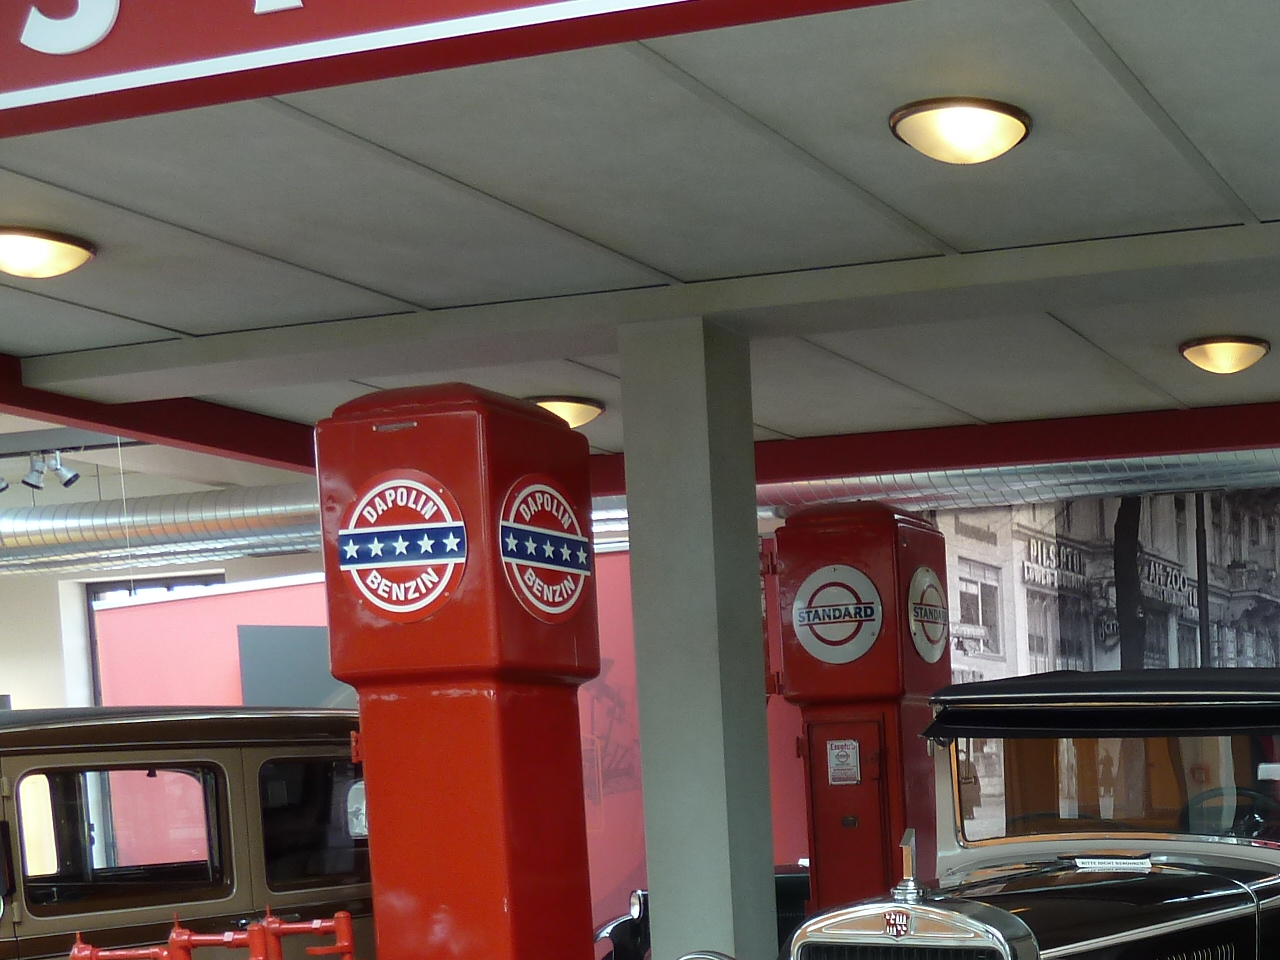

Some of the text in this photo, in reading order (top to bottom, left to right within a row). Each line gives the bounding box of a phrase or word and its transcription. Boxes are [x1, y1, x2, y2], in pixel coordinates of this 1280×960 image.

[362, 487, 438, 524] DAPOLIN
[519, 490, 573, 530] DAPOLIN
[366, 567, 440, 601] BENZIN
[523, 567, 576, 604] BENZIN
[798, 605, 875, 623] STANDARD
[913, 607, 948, 623] STANDARD
